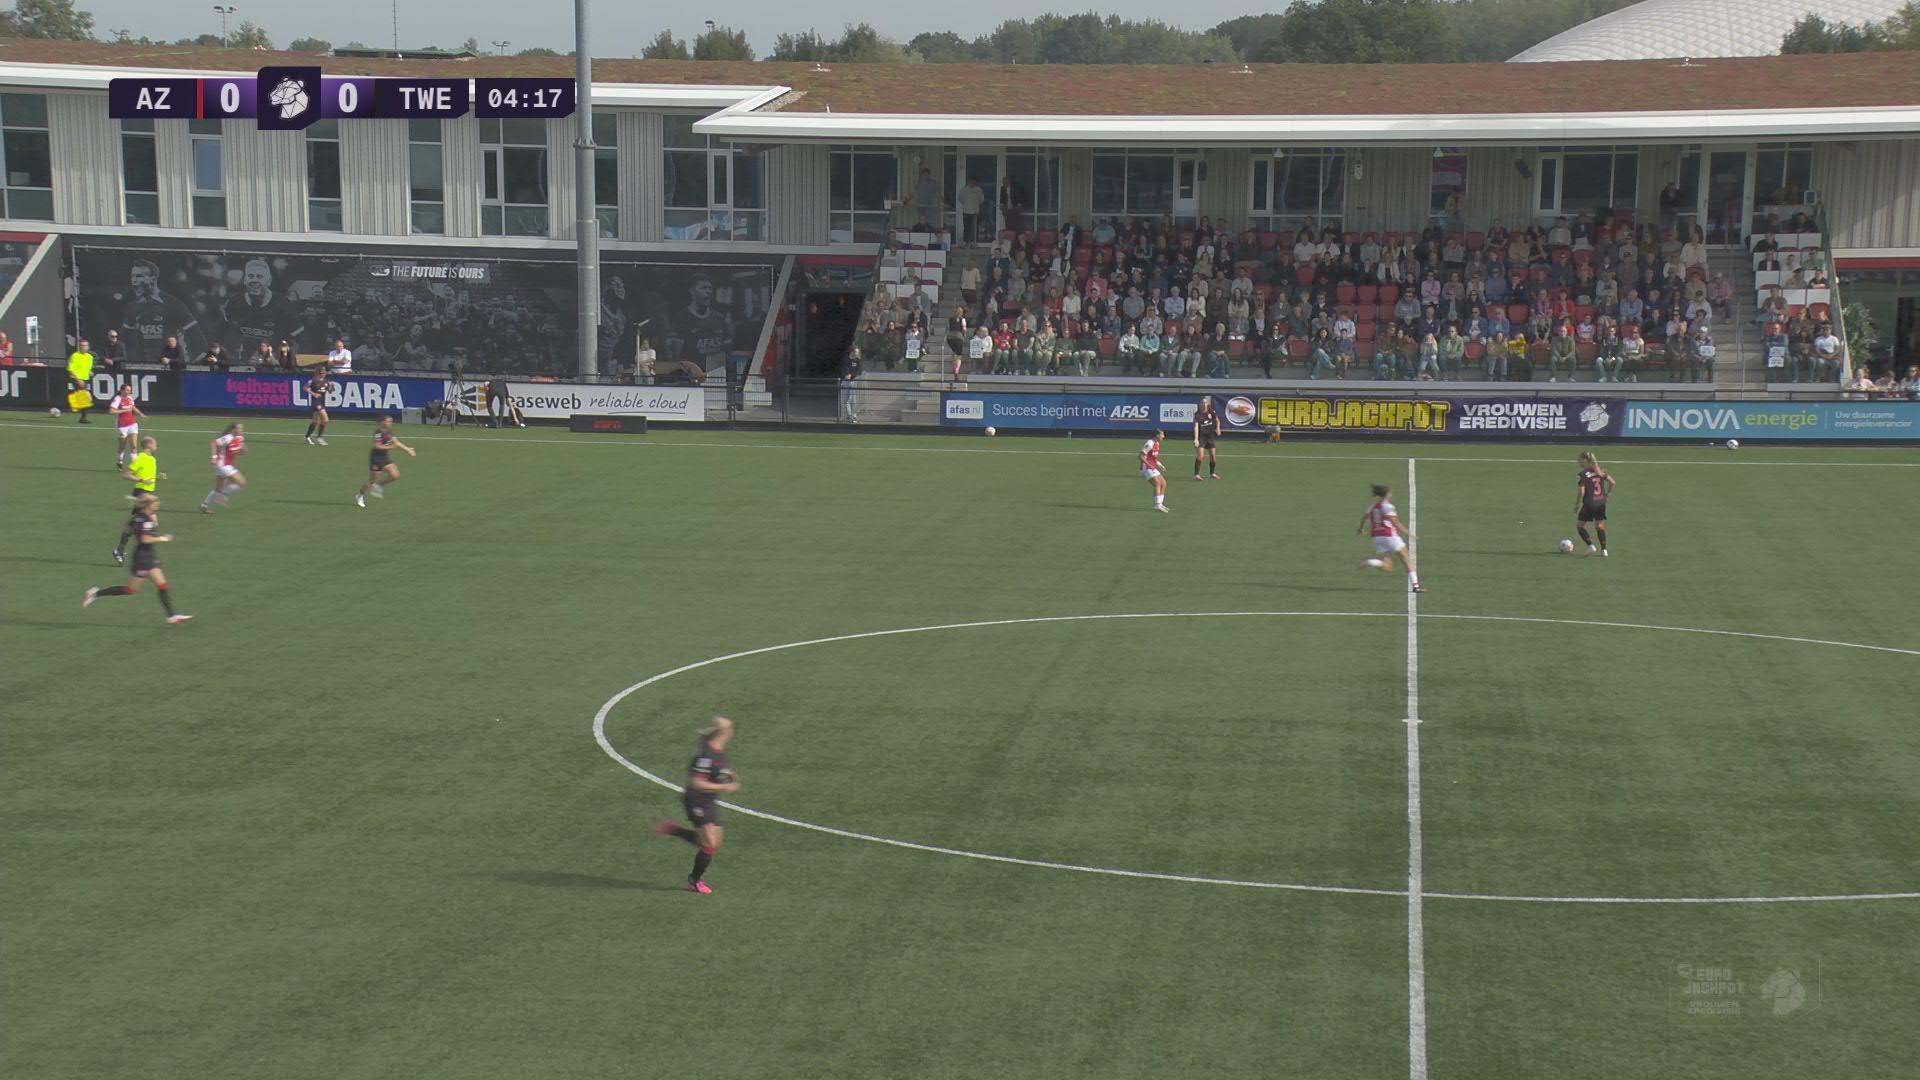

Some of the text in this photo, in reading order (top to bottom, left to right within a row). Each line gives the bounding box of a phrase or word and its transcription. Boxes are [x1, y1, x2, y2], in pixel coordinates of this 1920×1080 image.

[392, 265, 485, 279] THE FUTURE IS OURS
[68, 373, 157, 402] our
[227, 378, 289, 393] keihard
[236, 392, 289, 406] scoren
[292, 380, 404, 409] LBARA
[505, 392, 690, 410] easeweb reliable cloud
[992, 403, 1150, 420] Succes begint met AFAS
[1259, 398, 1450, 431] EUROJACKPOT
[1463, 403, 1564, 417] VROUWEN
[1834, 411, 1896, 419] Uw duurzame
[1459, 416, 1567, 429] EREDIVISIE
[1628, 409, 1819, 430] INNOVA energie
[1592, 507, 1602, 527] 3
